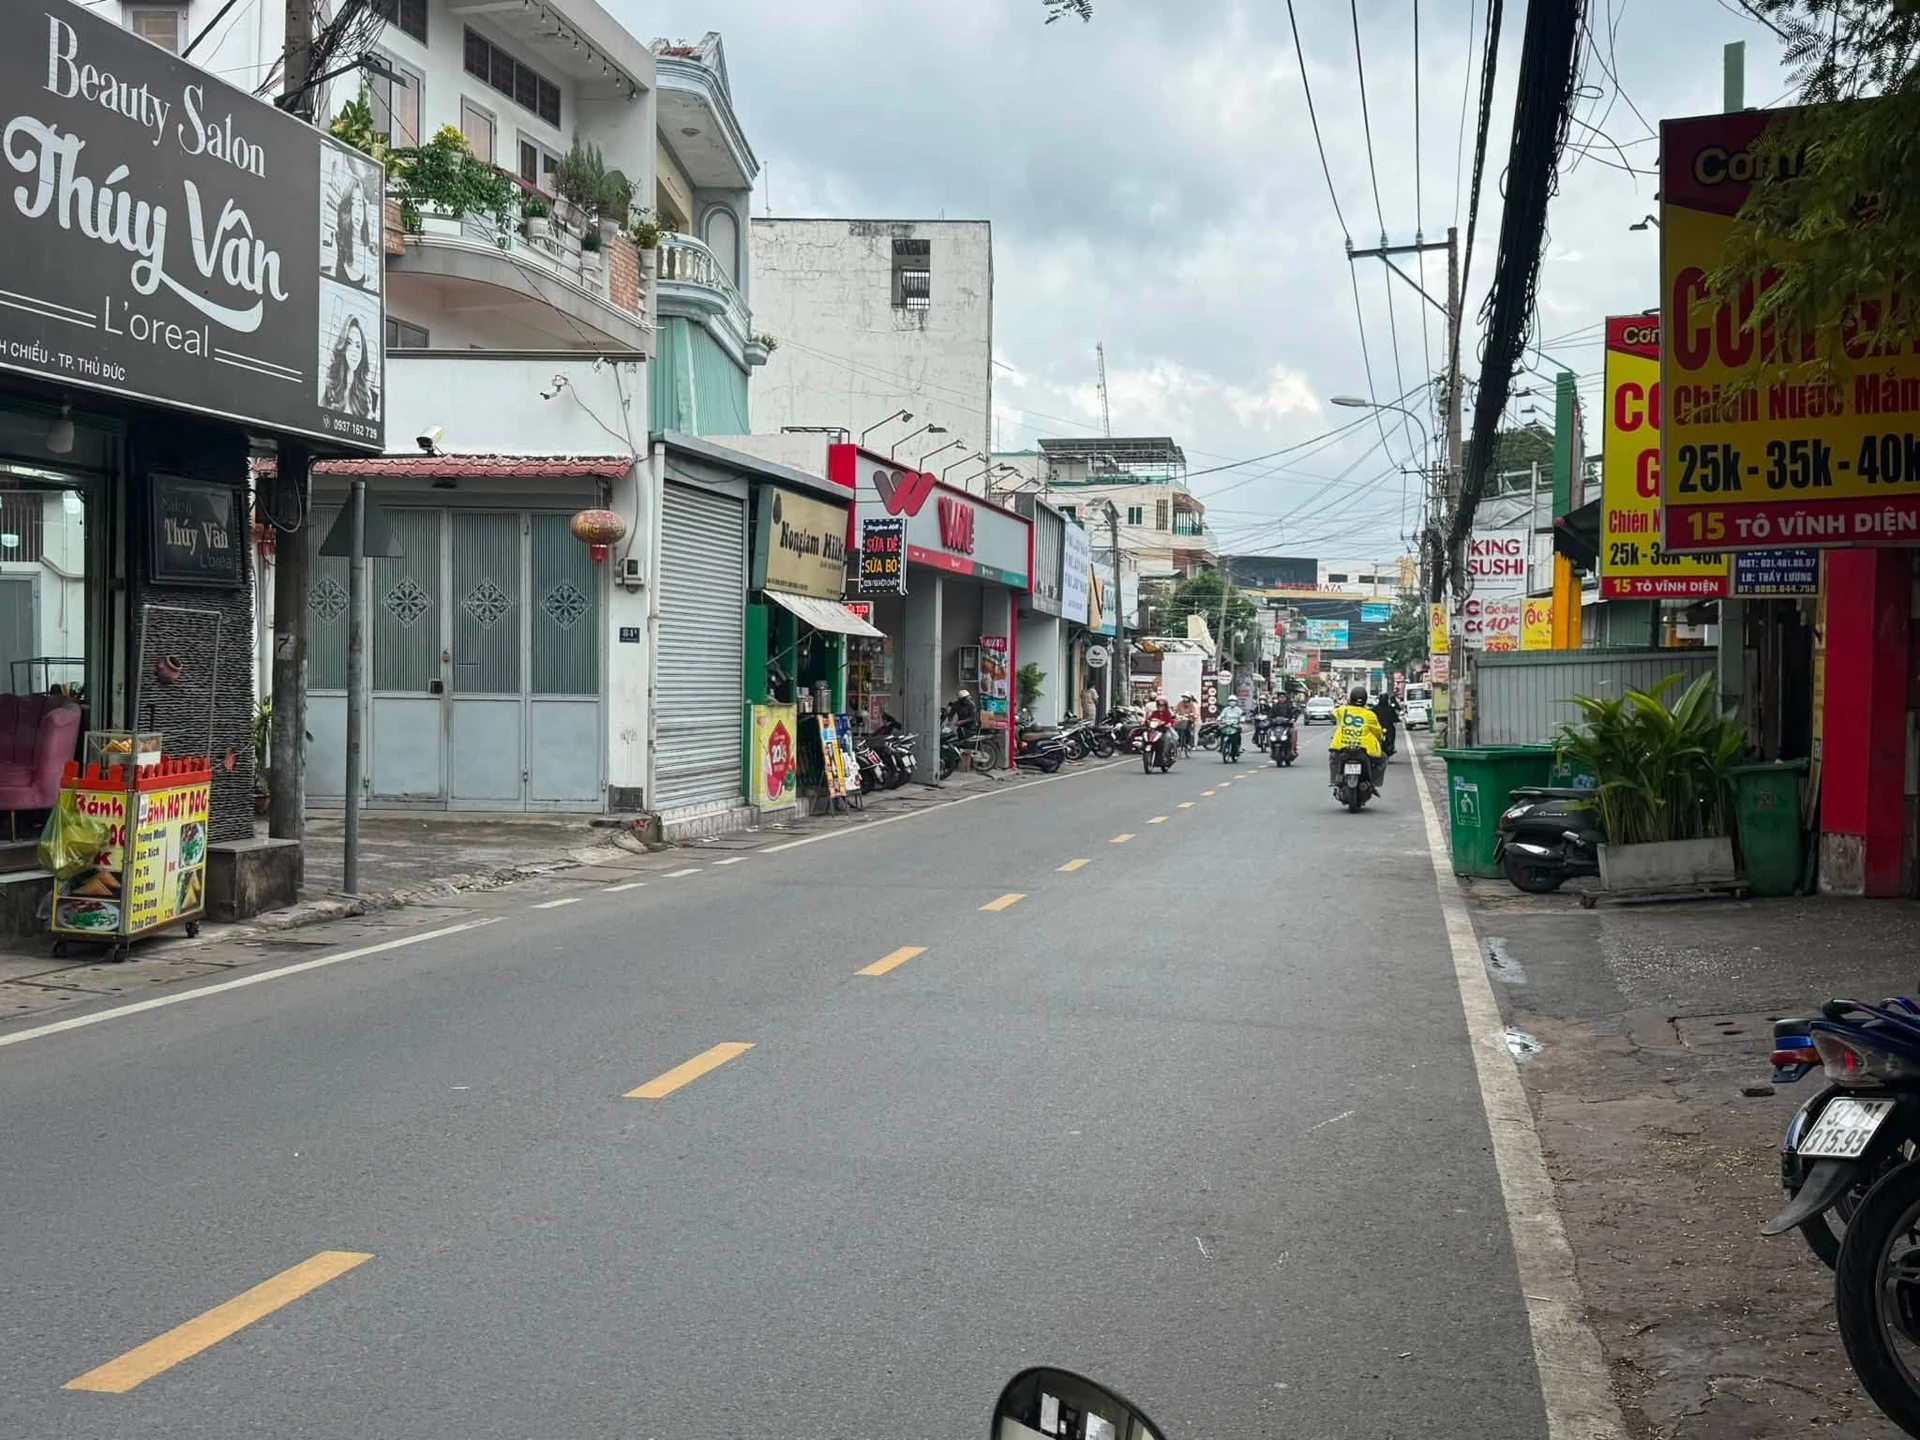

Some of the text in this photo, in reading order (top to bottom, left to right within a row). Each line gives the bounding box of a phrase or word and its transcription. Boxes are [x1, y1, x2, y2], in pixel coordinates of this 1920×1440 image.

[43, 12, 266, 179] Beauty Salon
[3, 115, 289, 303] Thúy Vân
[104, 296, 209, 359] L'oreal
[58, 353, 75, 370] TP.
[78, 356, 100, 376] THỦ
[103, 363, 126, 381] ĐỨC
[333, 419, 350, 433] 0937
[352, 423, 364, 436] 162
[1678, 443, 1742, 493] 25k
[1766, 438, 1833, 490] 35k
[1857, 432, 1920, 484] 40k
[164, 517, 198, 555] Thúy
[1687, 506, 1917, 541] 15 TÔ VĨNH DIỆN
[1470, 539, 1521, 556] KING
[1609, 542, 1640, 566] 25k
[1468, 559, 1524, 576] SUSHI
[1613, 579, 1719, 594] 15 TÔ VĨNH DIỆN
[1343, 709, 1365, 728] be
[147, 788, 208, 825] ánh HOT DOG
